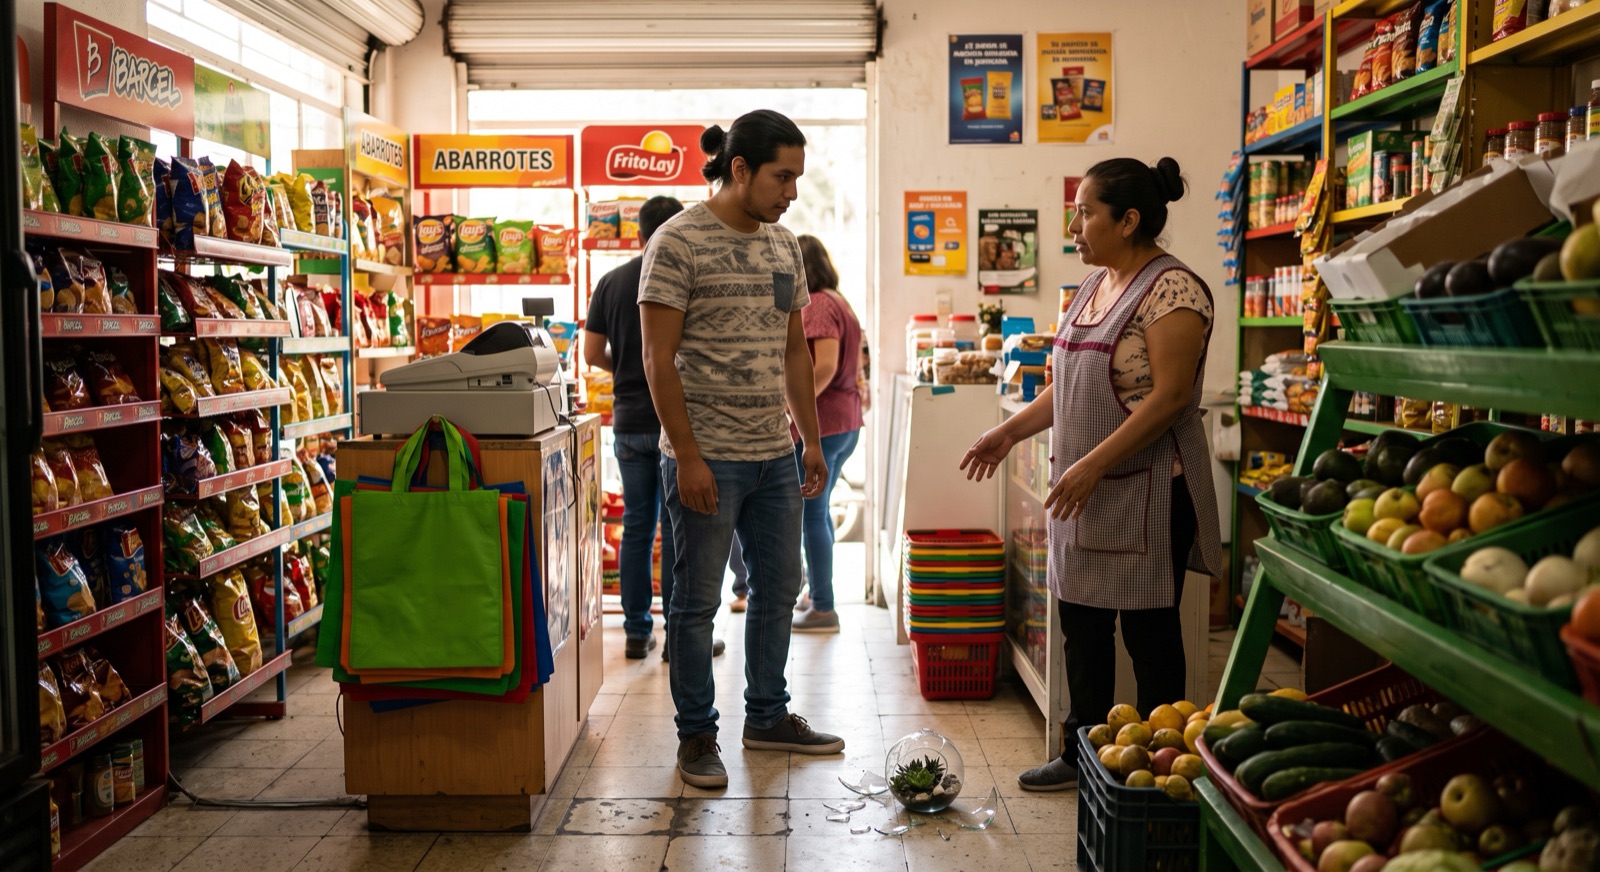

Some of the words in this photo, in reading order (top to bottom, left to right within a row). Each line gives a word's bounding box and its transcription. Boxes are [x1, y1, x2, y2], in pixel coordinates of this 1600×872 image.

[114, 49, 181, 106] BARCEL
[360, 131, 403, 168] ABARROTES
[434, 150, 553, 170] ABARROTES
